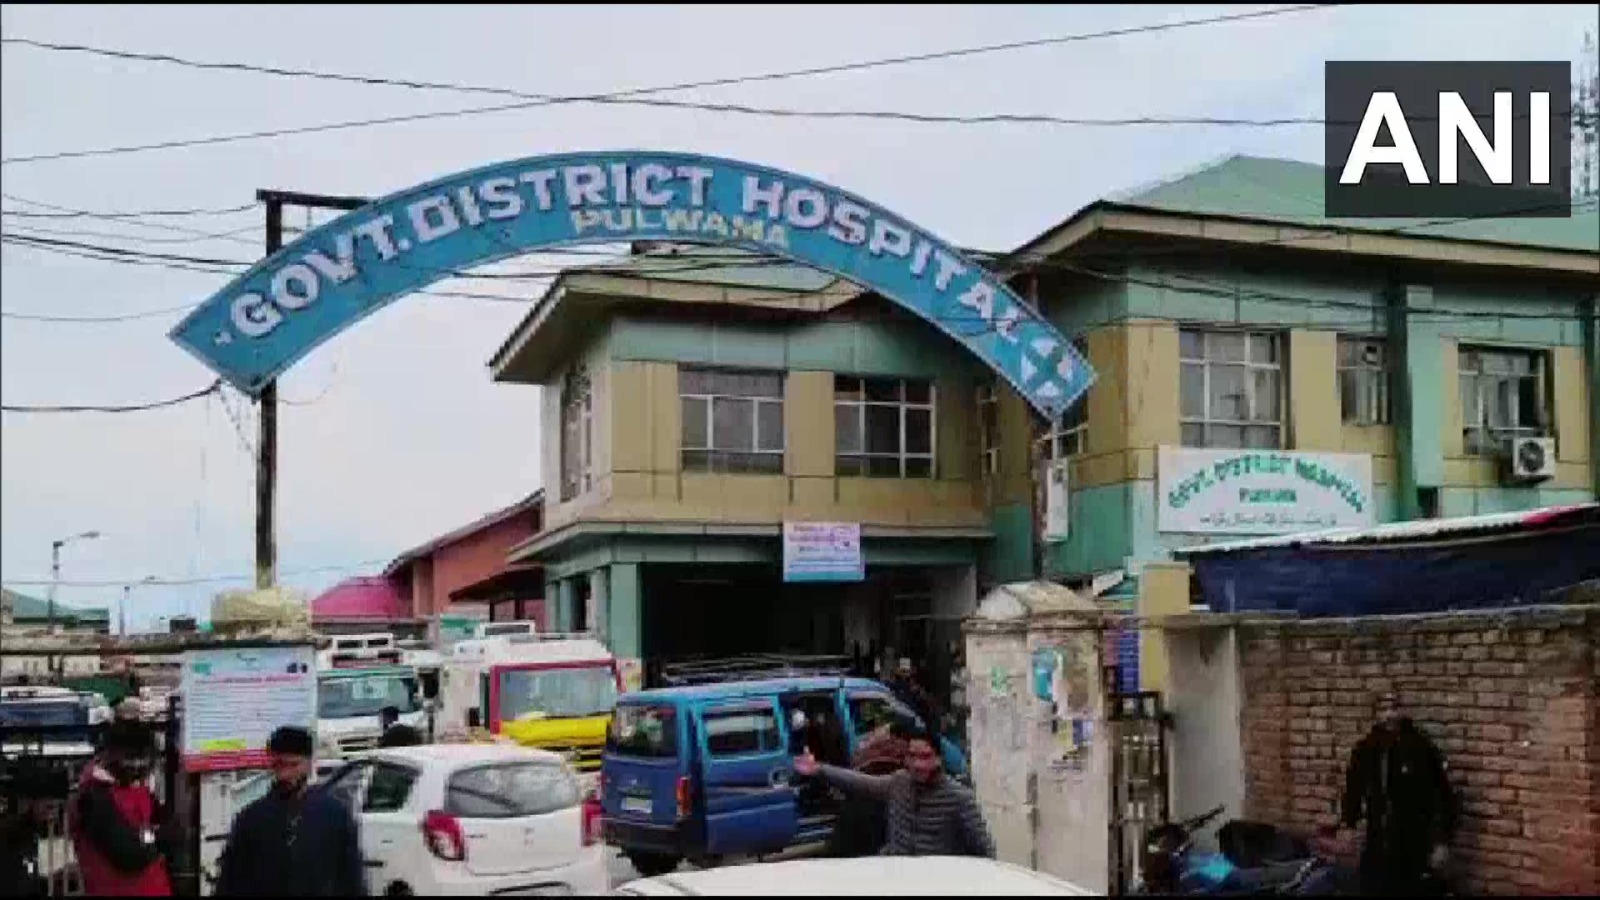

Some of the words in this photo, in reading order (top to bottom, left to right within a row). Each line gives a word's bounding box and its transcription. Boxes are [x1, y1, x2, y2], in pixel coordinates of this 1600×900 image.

[407, 163, 713, 242] DISTRICT
[742, 174, 1027, 345] HOSPITAL
[571, 206, 791, 248] PULWAMA
